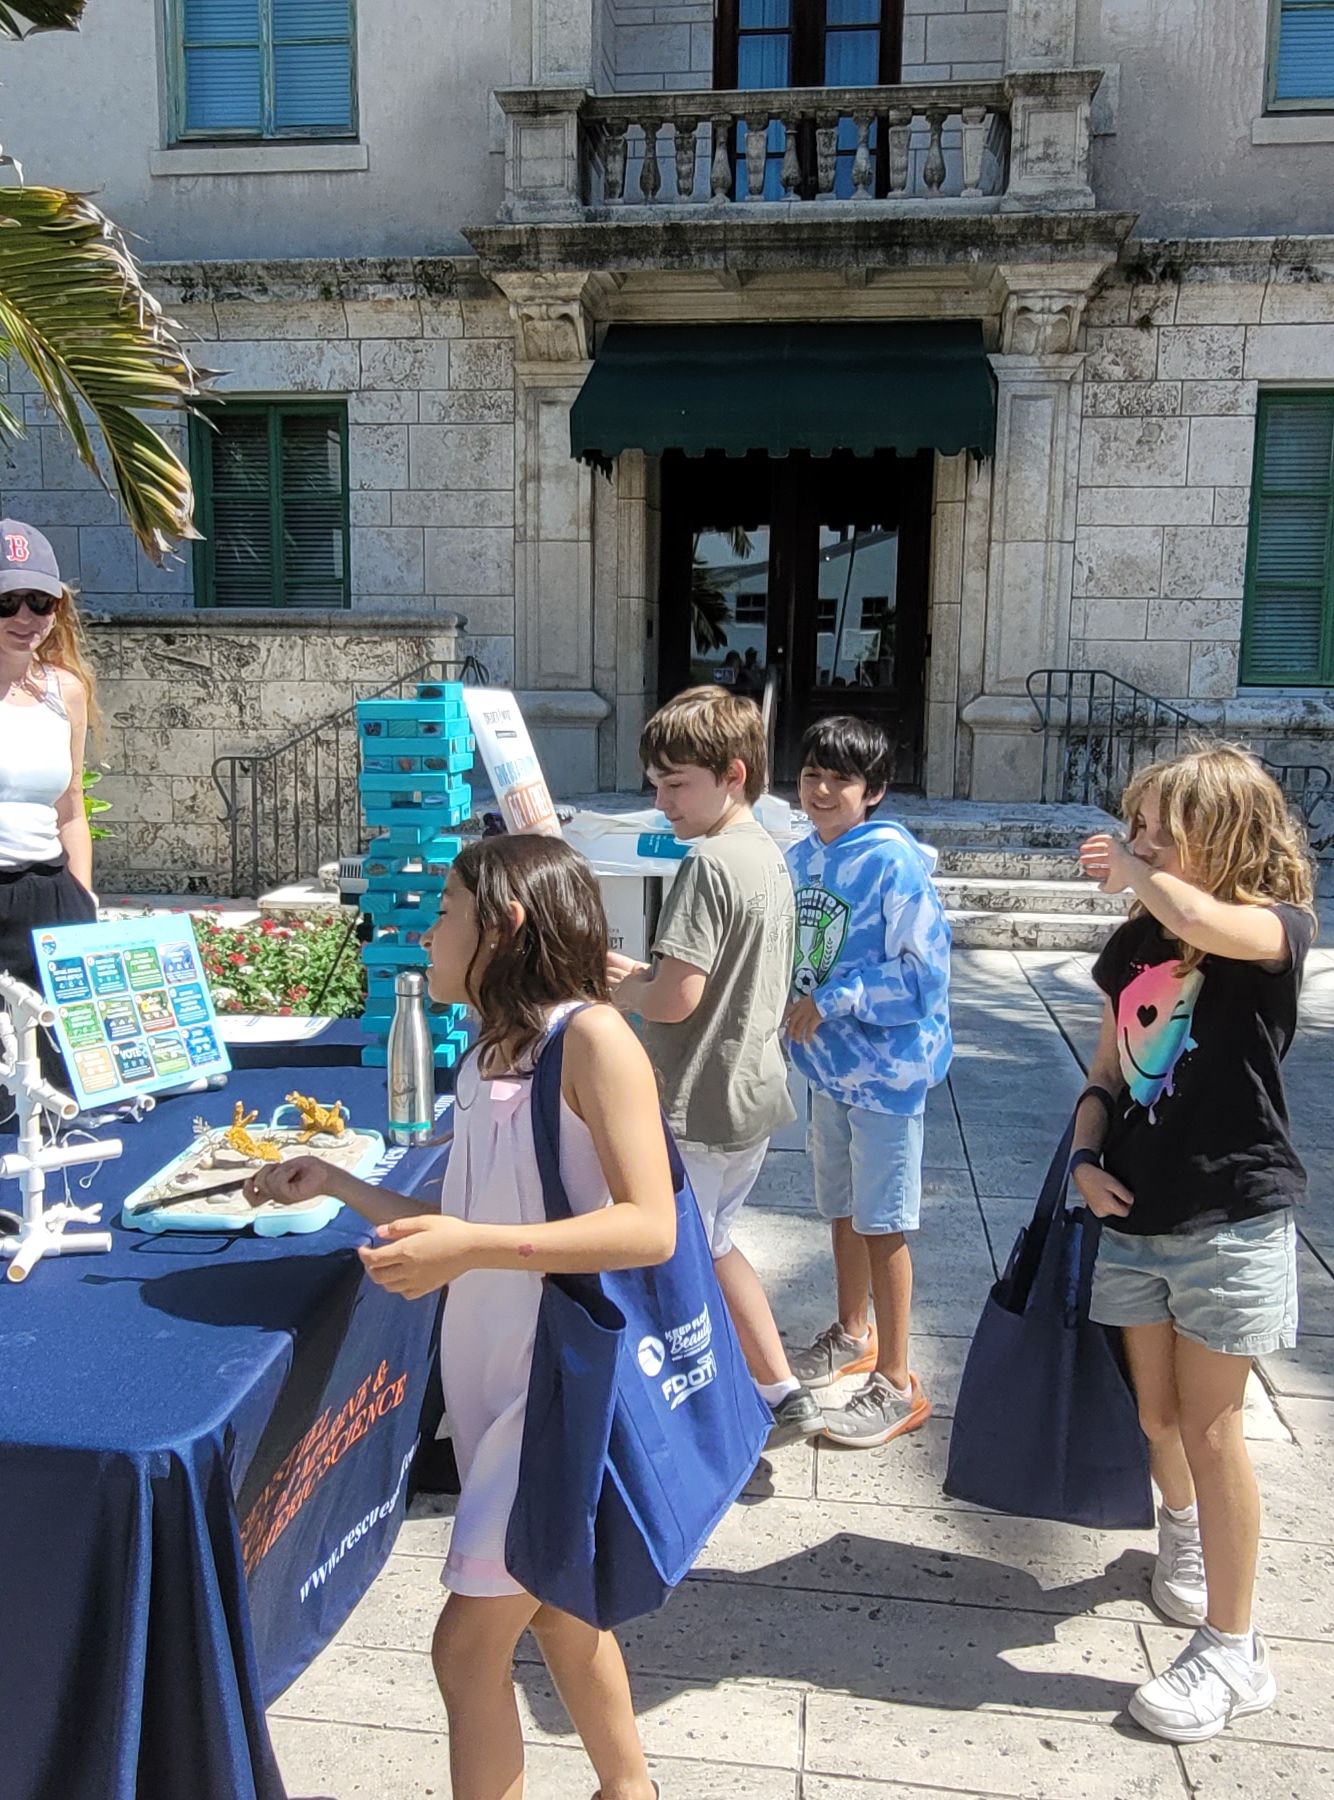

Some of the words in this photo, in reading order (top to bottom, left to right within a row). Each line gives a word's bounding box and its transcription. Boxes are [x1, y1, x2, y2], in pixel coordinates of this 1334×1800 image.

[5, 534, 30, 562] B
[120, 1047, 142, 1060] VOTE
[661, 1360, 713, 1402] FDOT
